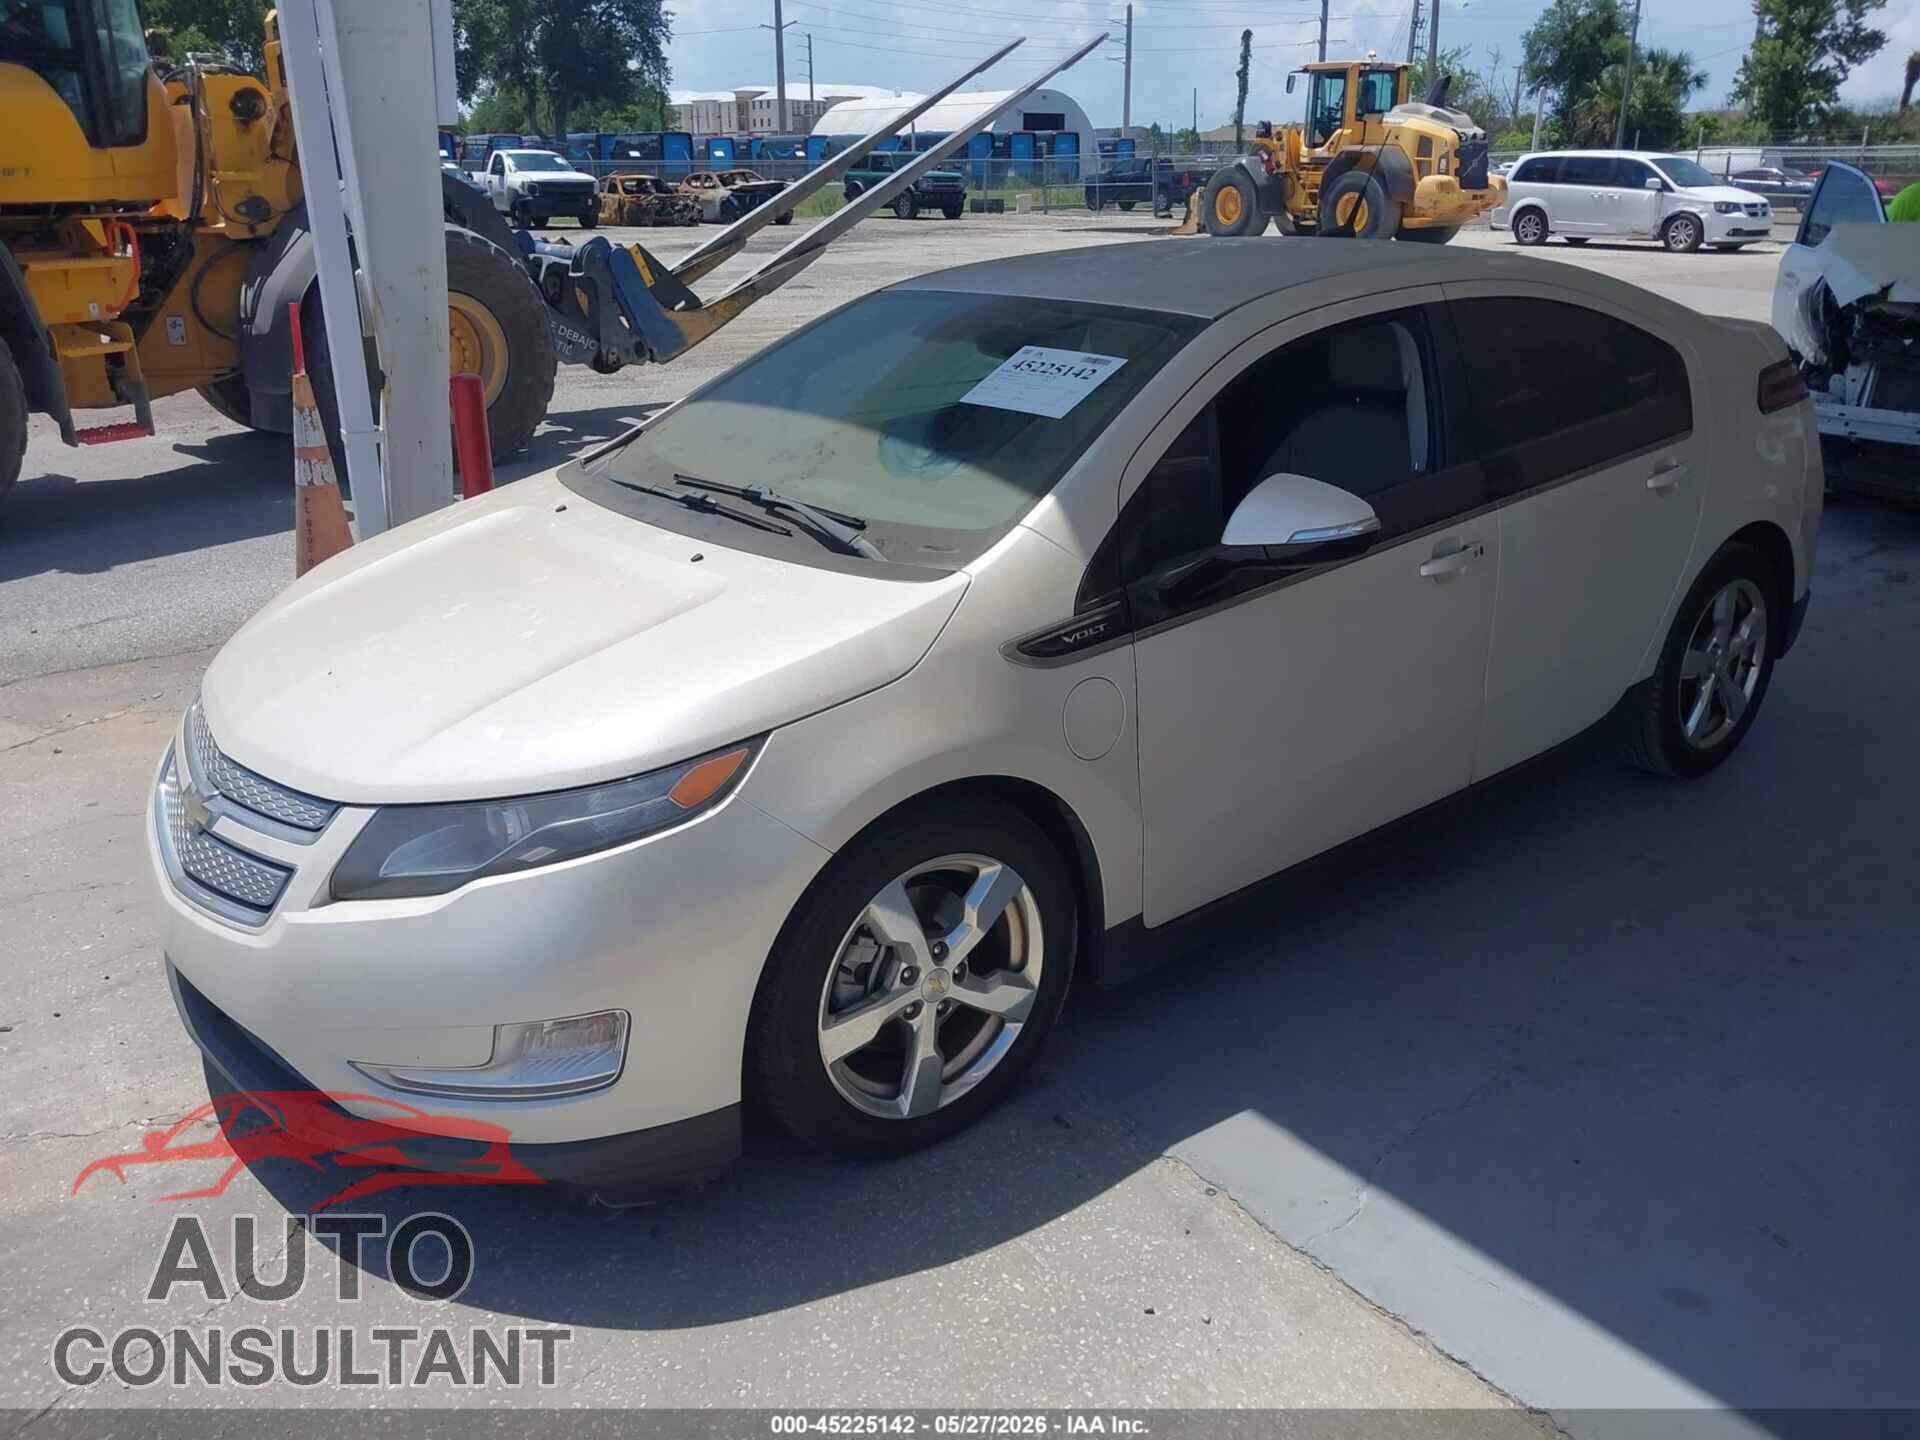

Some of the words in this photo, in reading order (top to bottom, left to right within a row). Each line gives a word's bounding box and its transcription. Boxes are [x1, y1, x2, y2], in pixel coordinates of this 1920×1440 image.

[558, 325, 598, 350] DEBAJO
[1013, 360, 1098, 380] 45225142
[1062, 624, 1106, 642] VOLT
